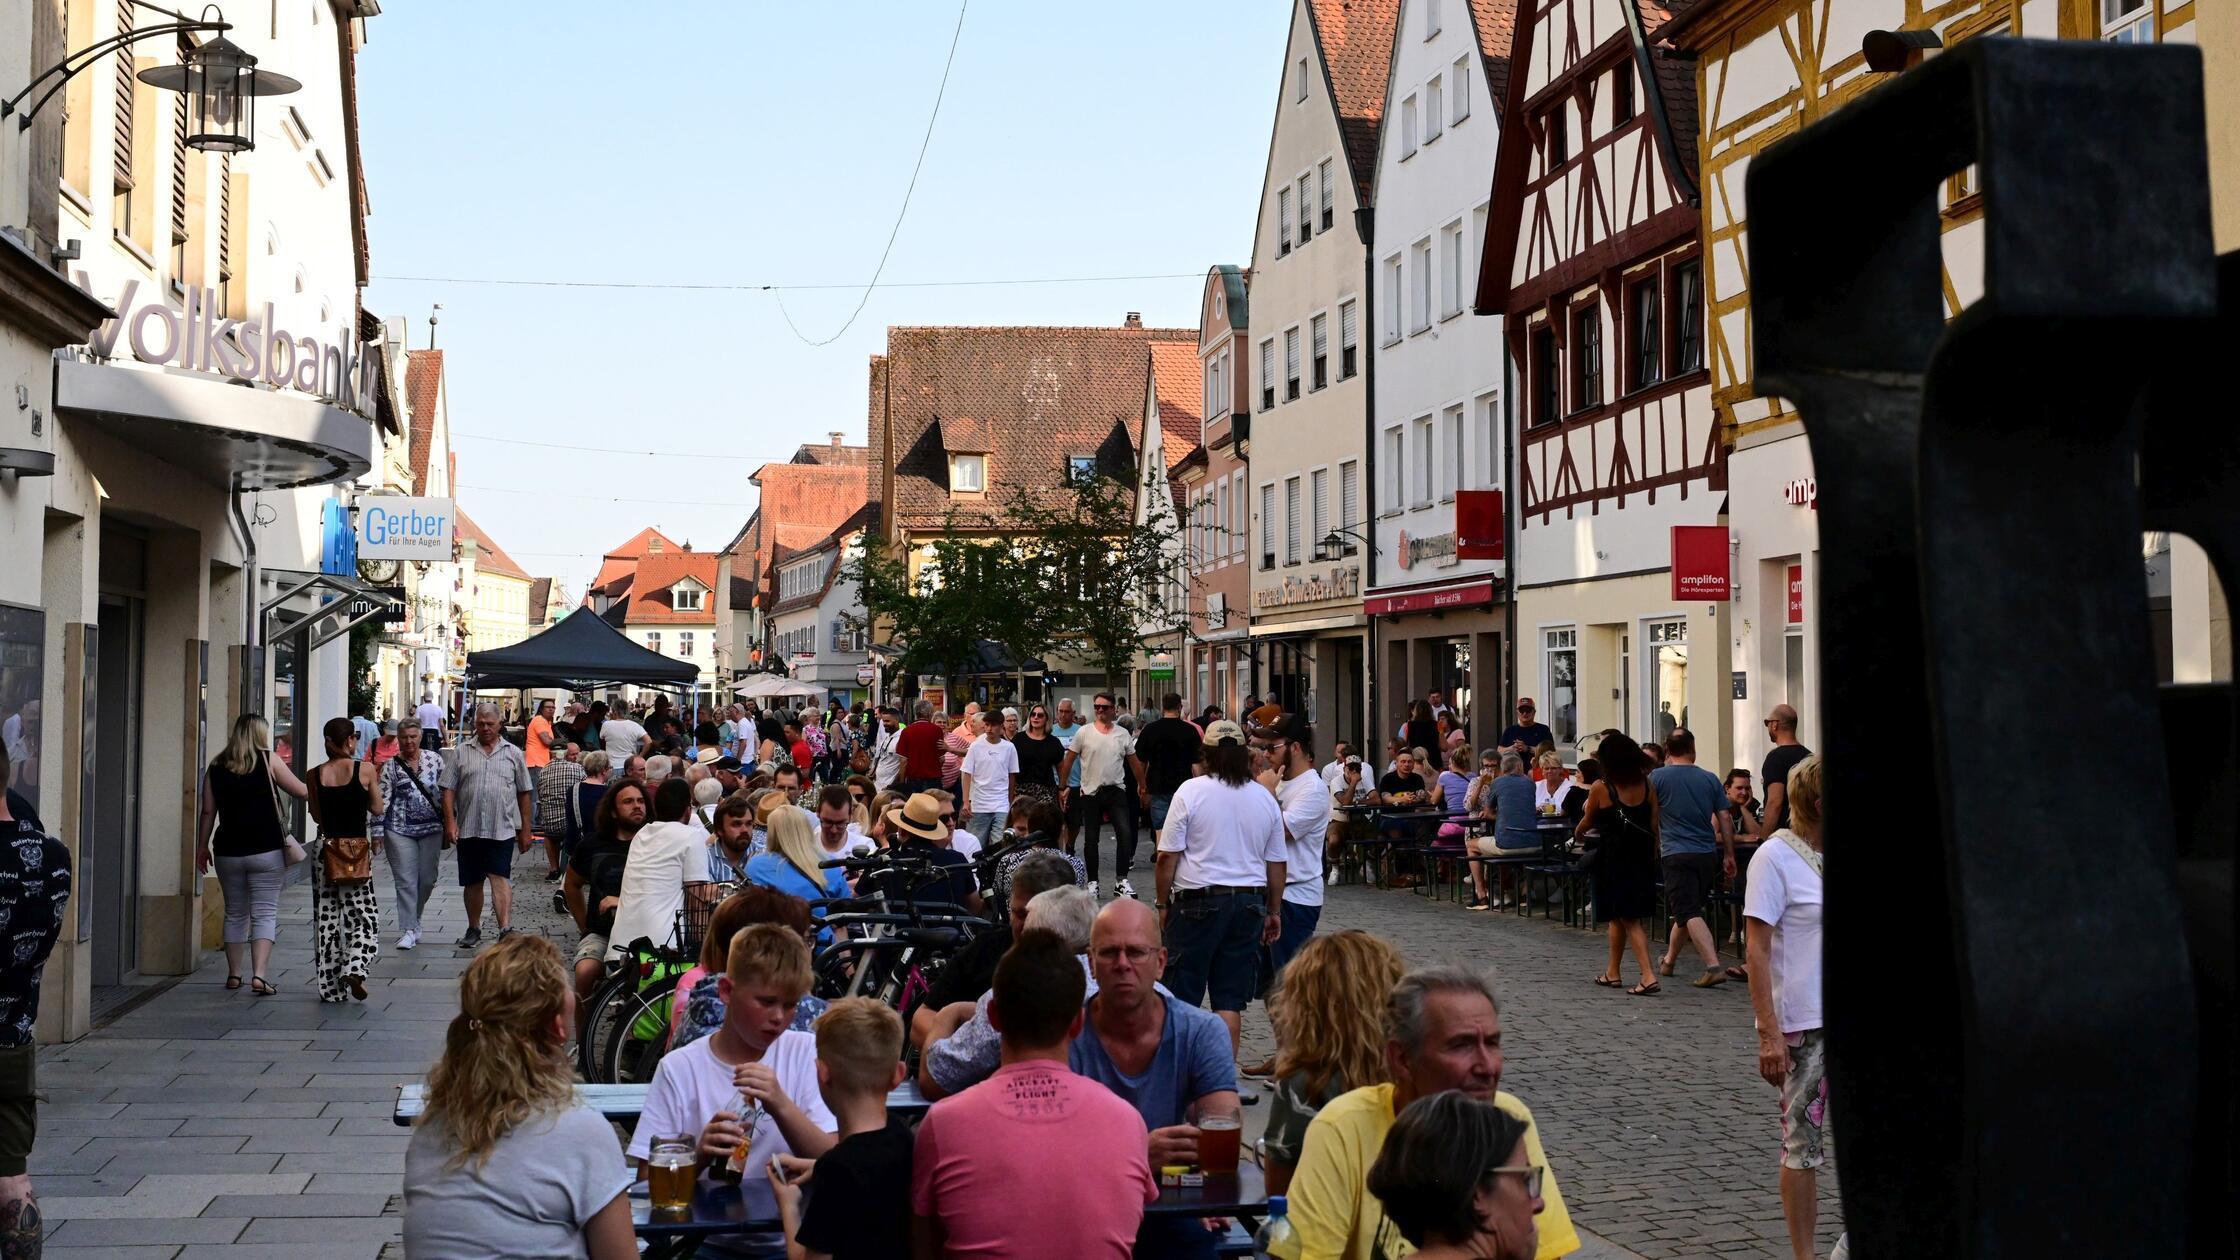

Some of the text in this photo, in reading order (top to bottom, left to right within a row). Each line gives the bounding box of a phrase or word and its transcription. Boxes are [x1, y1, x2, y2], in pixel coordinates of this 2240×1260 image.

[73, 269, 358, 410] Volksbank
[366, 507, 446, 545] Gerber
[389, 536, 441, 547] Für Ihre Augen
[1681, 574, 1725, 586] amplifon
[1006, 1078, 1060, 1089] AIRCRAFT
[1015, 1090, 1056, 1100] FLIGHT
